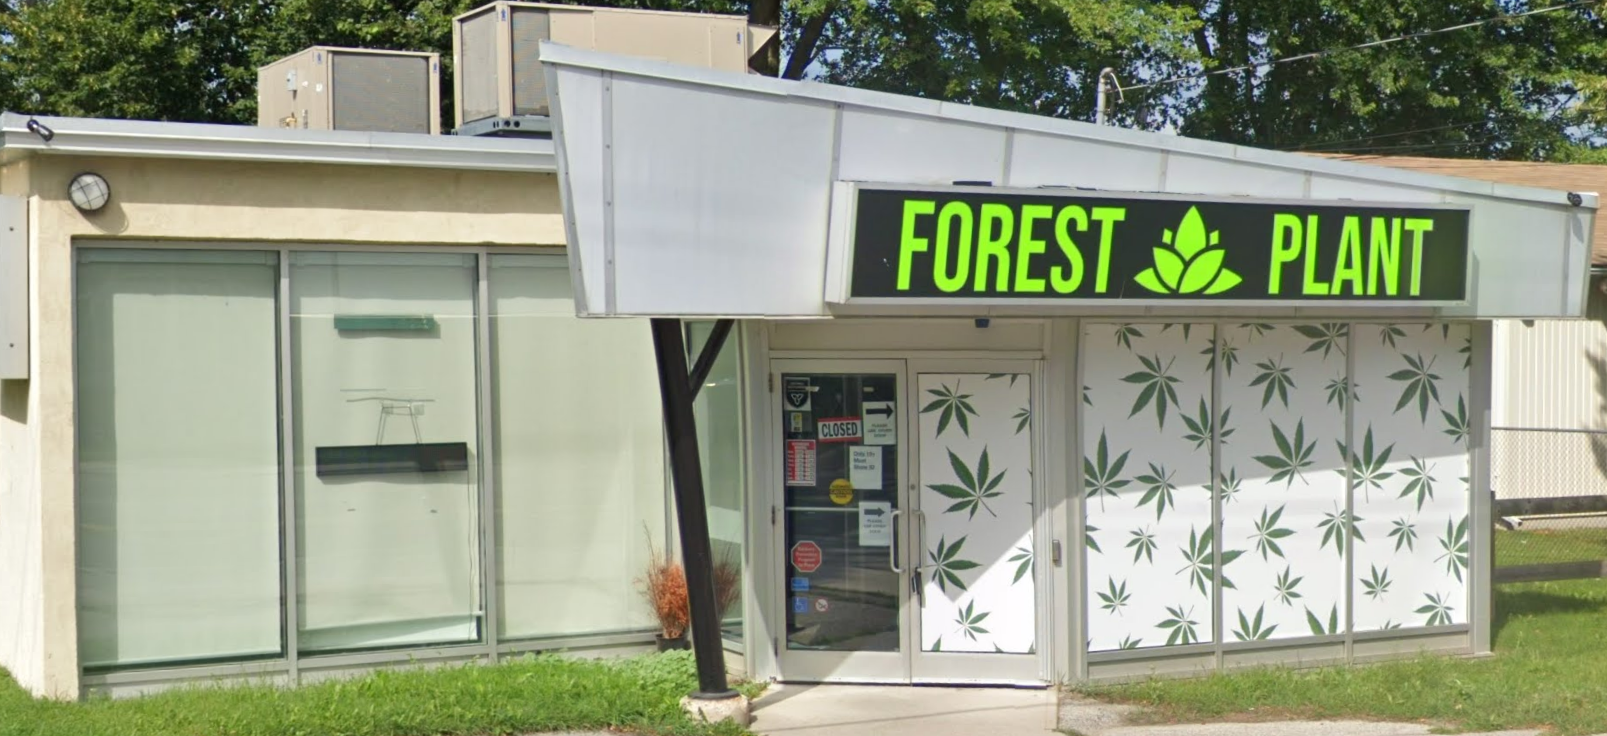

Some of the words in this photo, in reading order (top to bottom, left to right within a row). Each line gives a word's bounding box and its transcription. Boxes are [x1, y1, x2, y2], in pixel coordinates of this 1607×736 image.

[896, 199, 1126, 294] FOREST
[1268, 213, 1434, 296] PLANT
[821, 421, 858, 438] CLOSED
